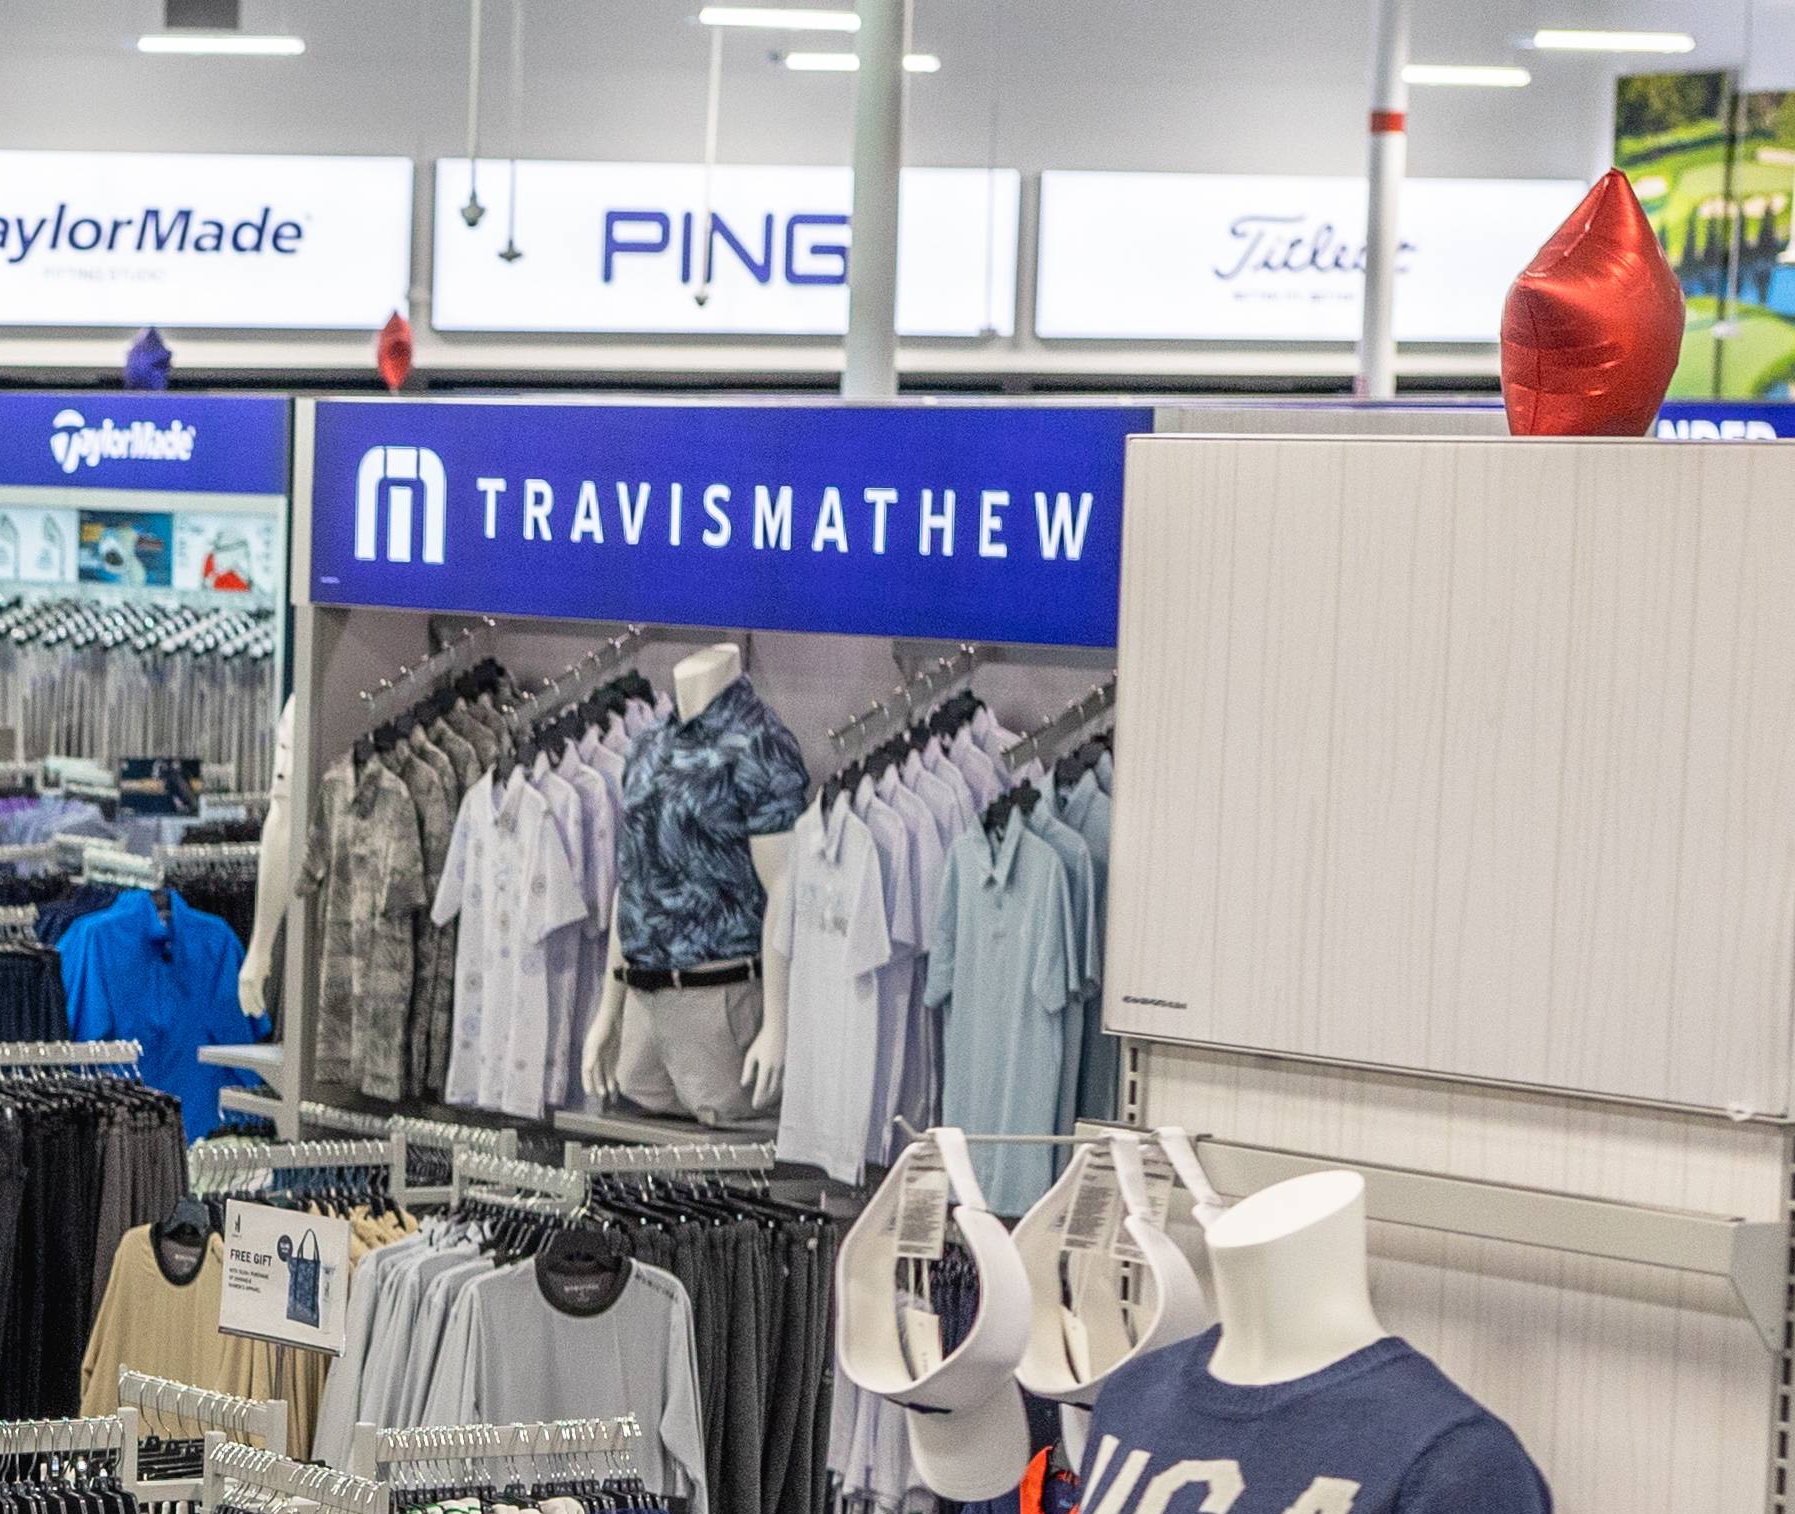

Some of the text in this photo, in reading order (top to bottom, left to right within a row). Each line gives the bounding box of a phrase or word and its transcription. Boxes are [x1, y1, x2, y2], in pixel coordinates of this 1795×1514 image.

[602, 210, 851, 285] PING
[476, 476, 1093, 562] TRAVISMATHEW
[230, 1248, 272, 1267] FREE GIFT
